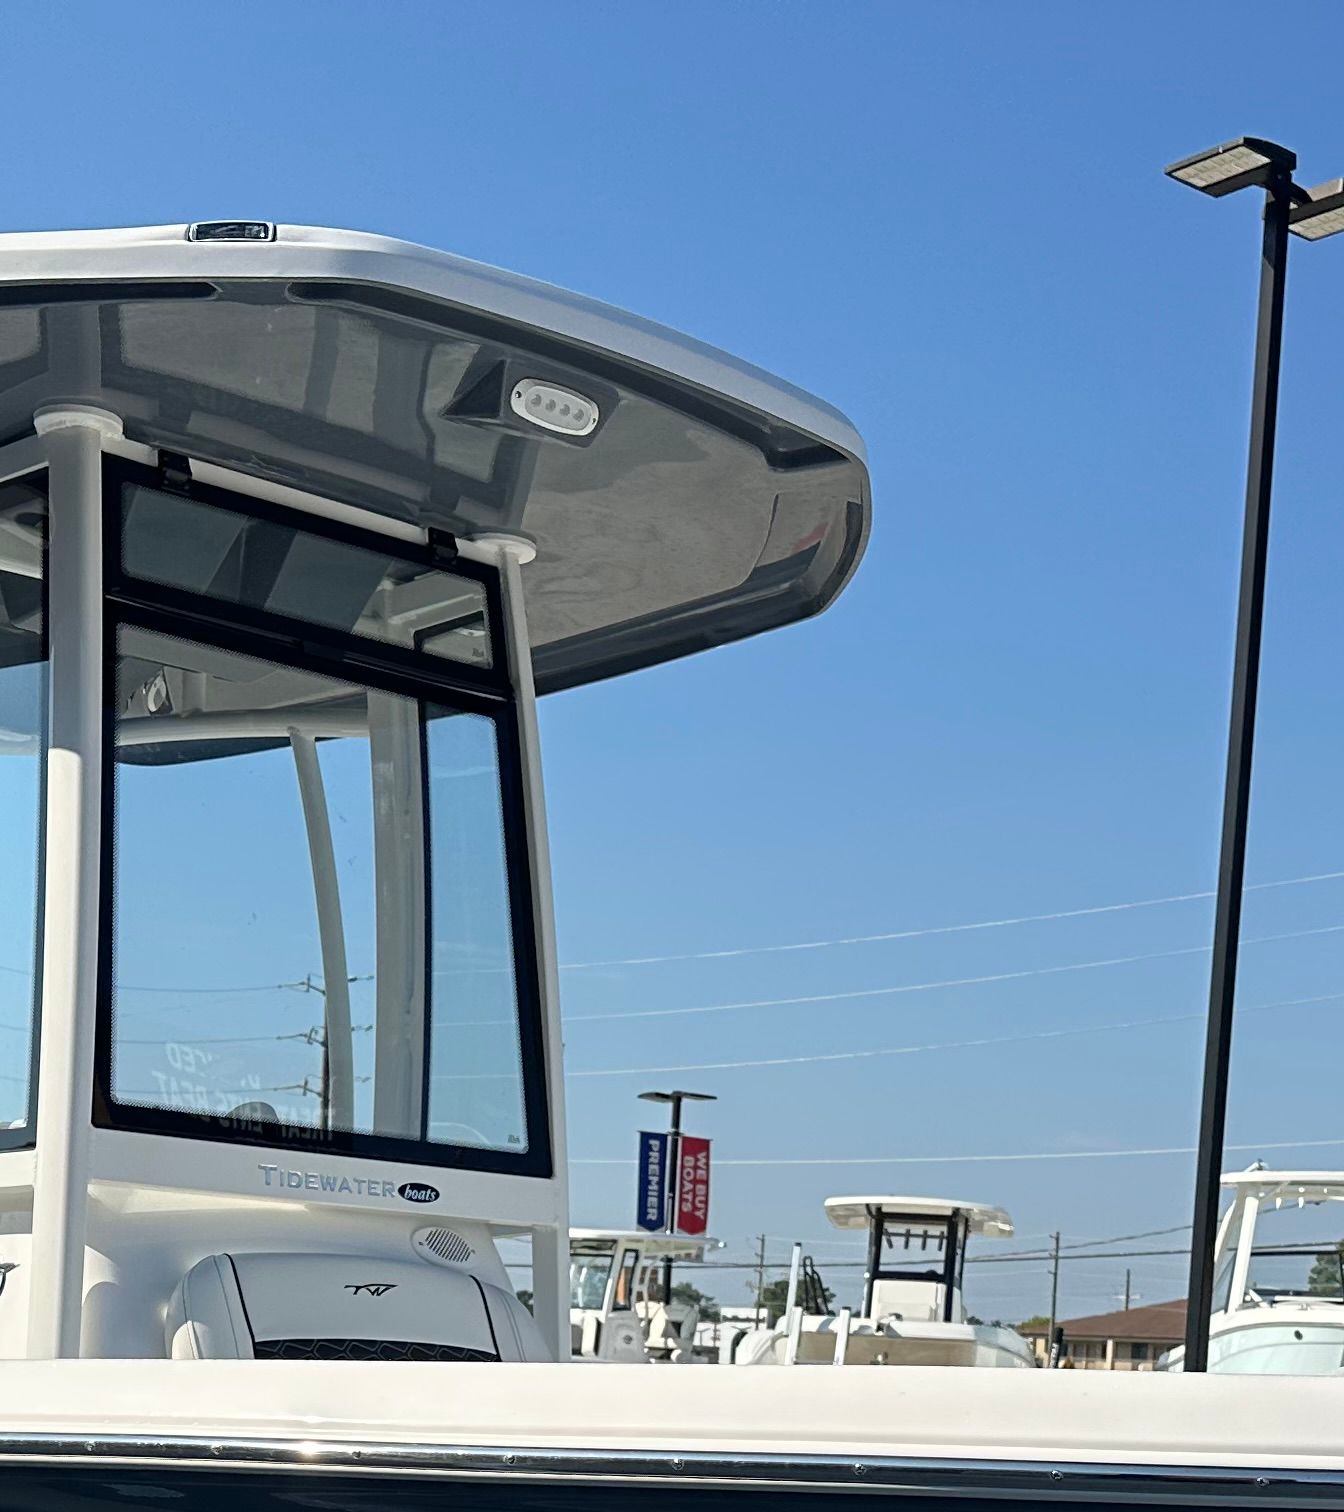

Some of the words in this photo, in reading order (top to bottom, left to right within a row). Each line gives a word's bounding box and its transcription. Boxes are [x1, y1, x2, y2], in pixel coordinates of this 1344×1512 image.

[258, 1164, 396, 1198] TIDEWATER
[404, 1184, 437, 1201] boats
[647, 1140, 660, 1221] PREMIER
[681, 1156, 695, 1213] BOATS
[696, 1151, 707, 1181] WE
[694, 1184, 707, 1220] BUY
